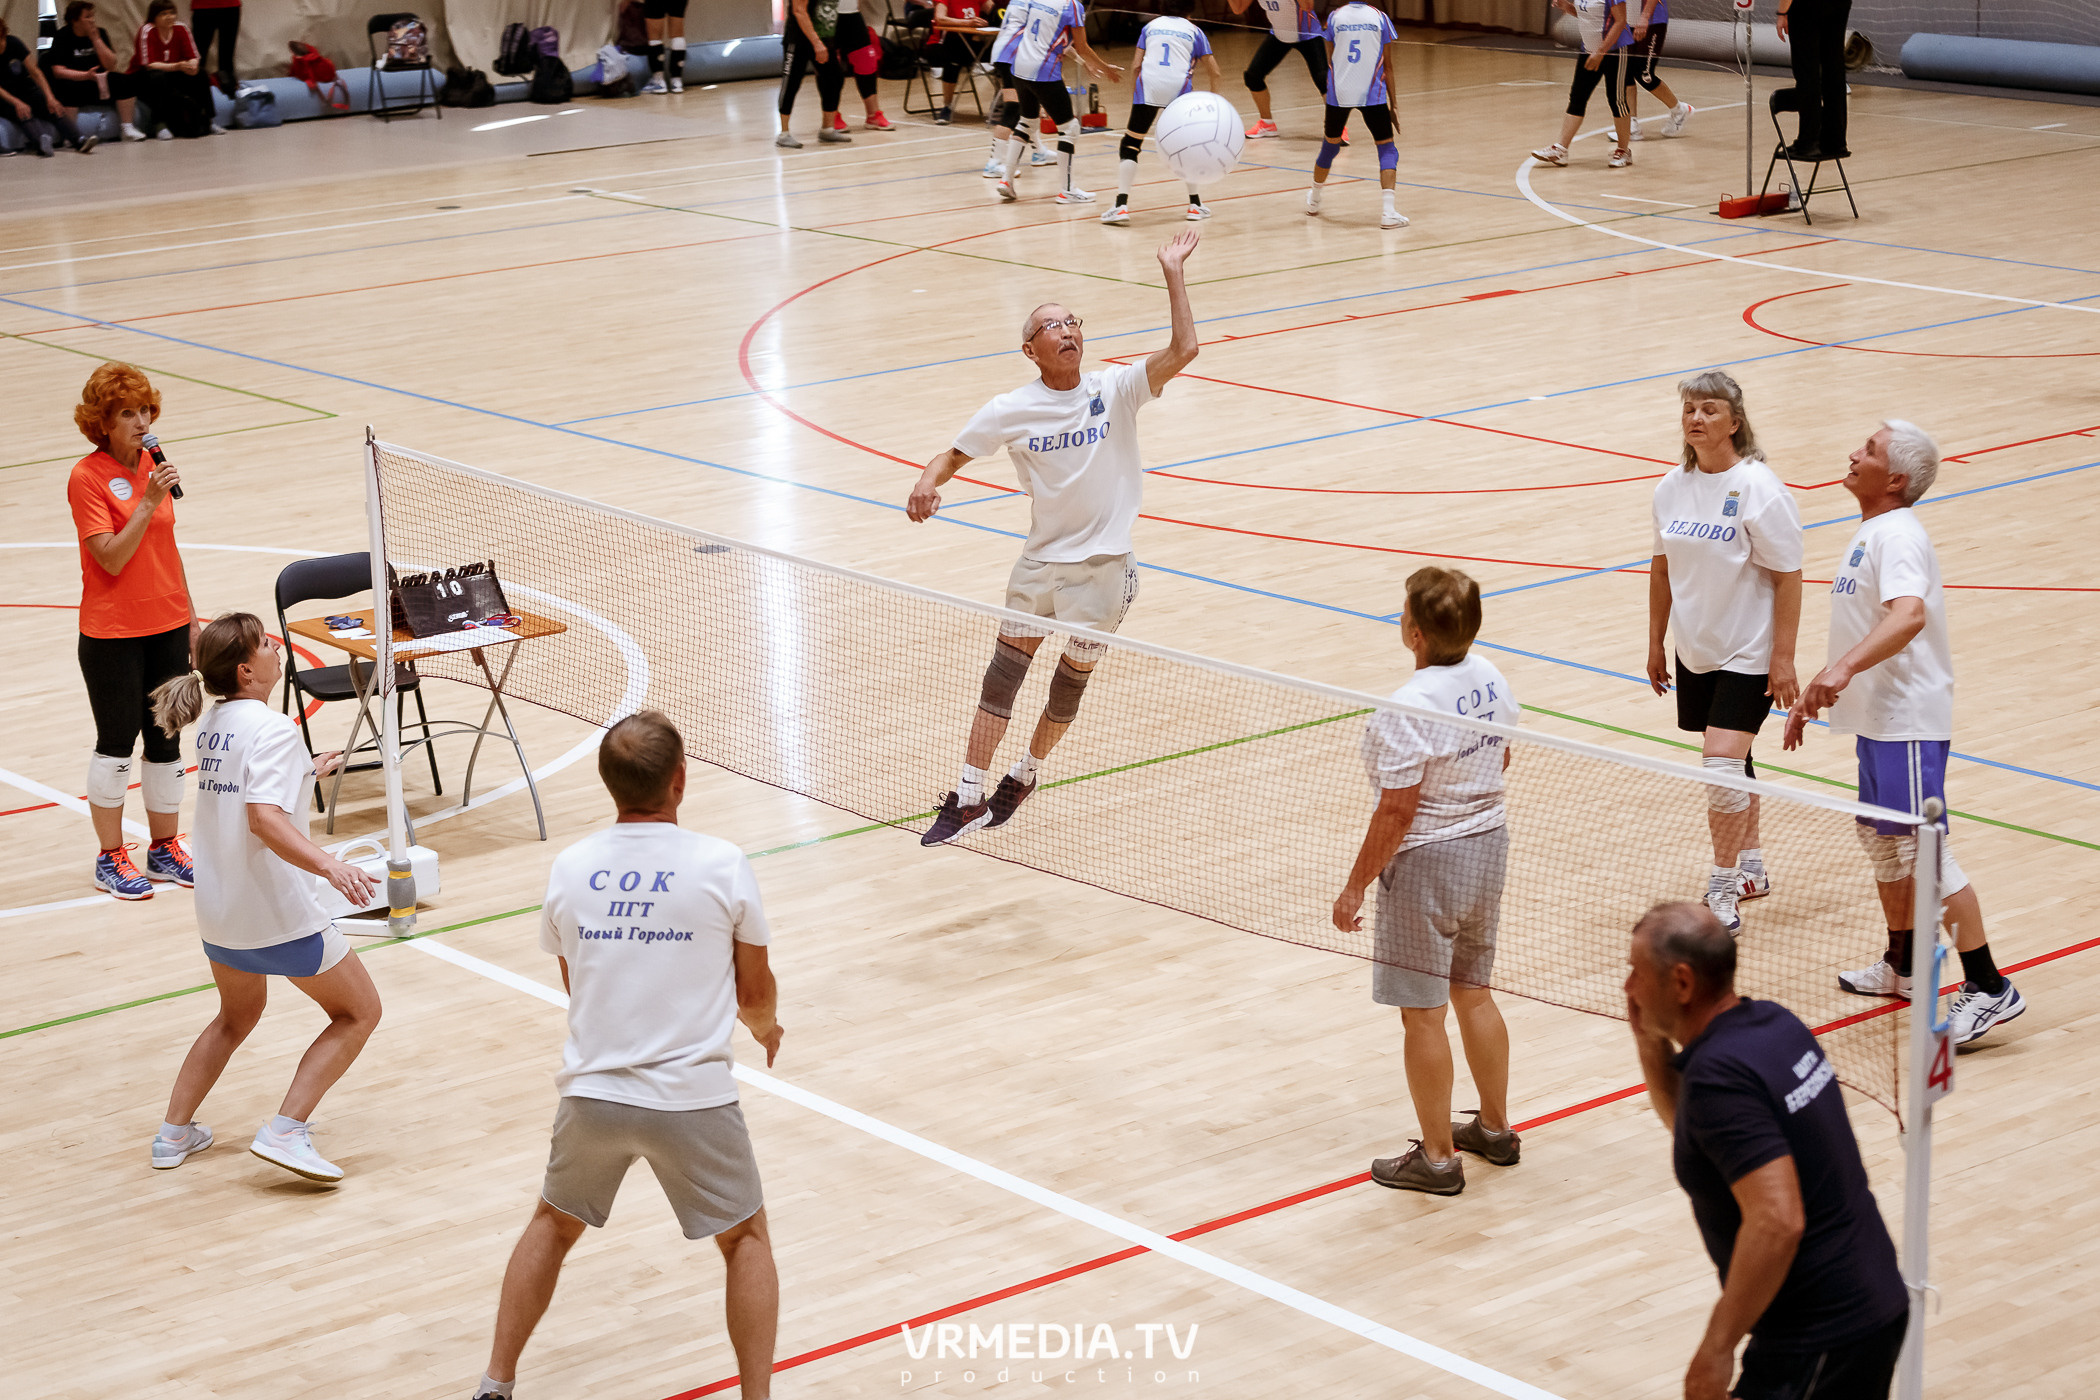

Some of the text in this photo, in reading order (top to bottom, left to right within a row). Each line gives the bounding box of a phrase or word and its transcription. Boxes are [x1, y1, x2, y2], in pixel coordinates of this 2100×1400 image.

[1266, 1, 1280, 11] 10
[1031, 18, 1041, 42] 4
[1159, 43, 1171, 67] 1
[1347, 39, 1361, 64] 5
[1028, 421, 1111, 453] БЕЛОВО
[1666, 520, 1737, 543] БЕЛОВО
[196, 731, 235, 752] СОК
[200, 757, 223, 773] ПГТ
[589, 870, 676, 893] СОК
[607, 901, 655, 918] ПГТ
[628, 926, 694, 944] Городок
[1927, 1035, 1953, 1092] 4
